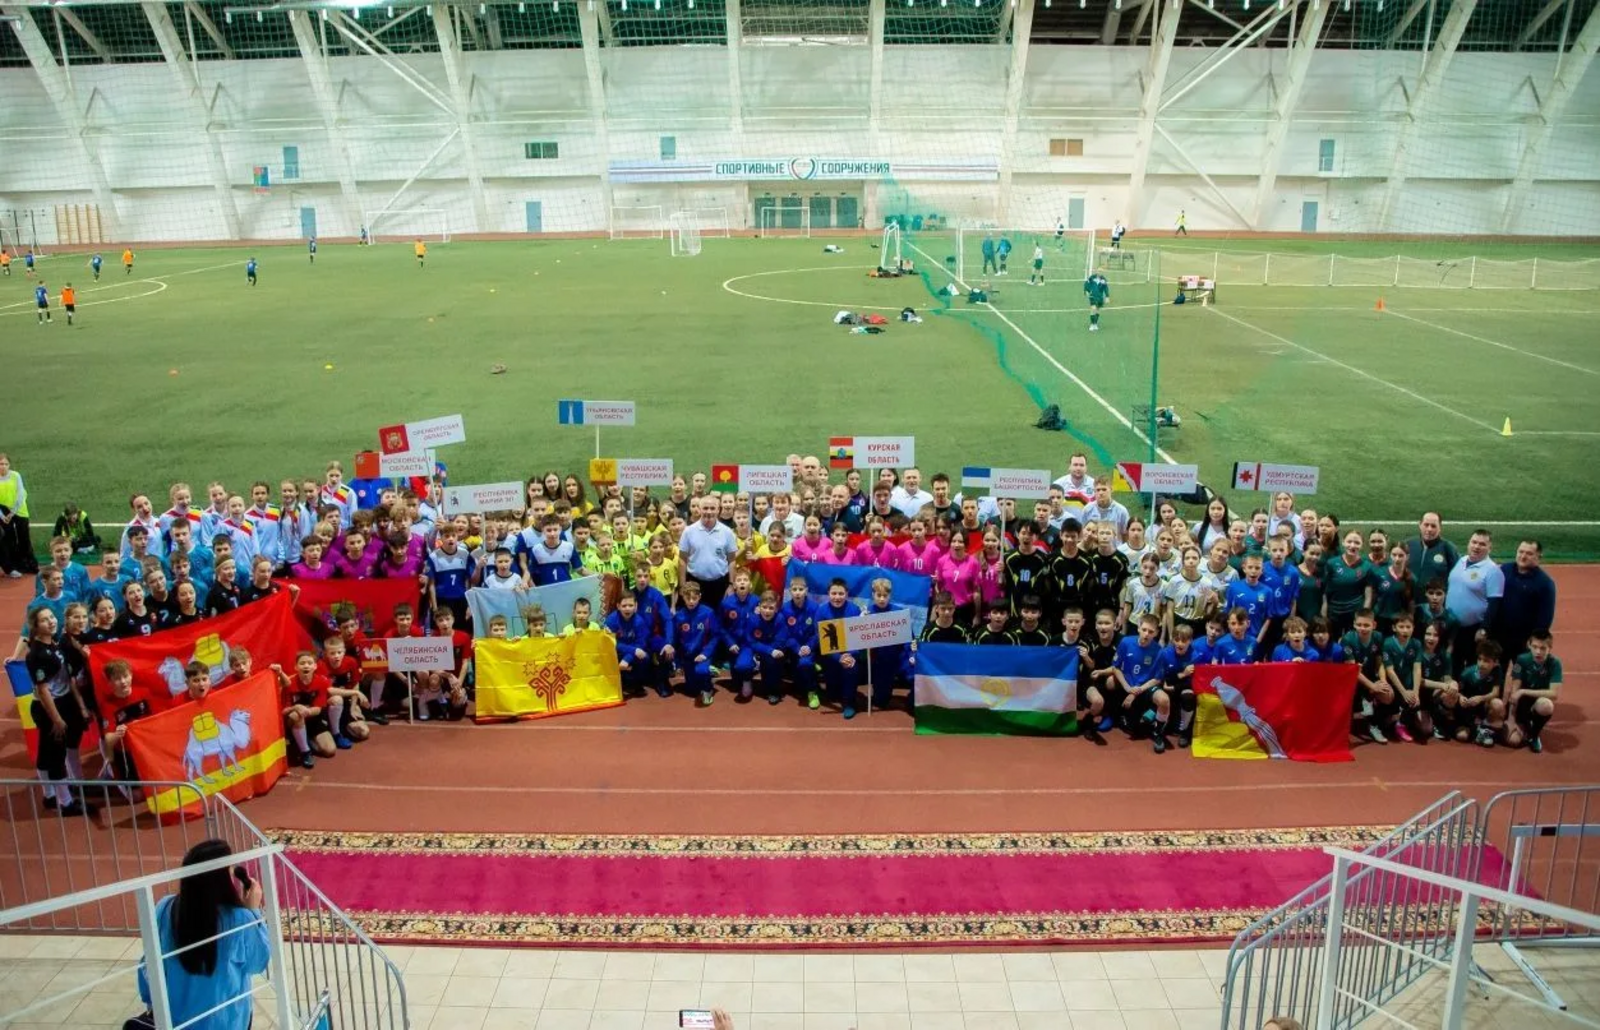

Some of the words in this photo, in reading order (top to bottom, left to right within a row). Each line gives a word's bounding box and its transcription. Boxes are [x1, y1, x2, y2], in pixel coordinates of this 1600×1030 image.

[715, 162, 785, 175] СПОРТИВНЫЕ
[821, 162, 890, 174] СООРУЖЕНИЯ
[867, 443, 901, 452] КУРСКАЯ
[867, 456, 900, 464] ОБЛАСТЬ
[389, 464, 423, 472] ОБЛАСТЬ
[746, 471, 788, 479] ЛИПЕЦКАЯ
[1266, 470, 1315, 480] УДМУРТСКАЯ
[1265, 479, 1314, 488] РЕСПУБЛИКА
[473, 489, 518, 499] РЕСПУБЛИКА
[850, 505, 861, 515] 10
[913, 558, 923, 569] 10
[552, 568, 558, 580] 1
[953, 570, 960, 583] 7
[1020, 569, 1031, 582] 10
[1101, 572, 1108, 584] 5
[450, 574, 457, 586] 7
[1067, 573, 1074, 587] 8
[1274, 587, 1282, 598] 6
[1184, 594, 1195, 608] 11
[1143, 601, 1151, 613] 3
[1248, 603, 1256, 615] 2
[159, 609, 169, 622] 7
[140, 624, 151, 636] 9
[848, 618, 907, 633] ЯРОСЛАВСКАЯ
[860, 630, 897, 641] ОБЛАСТЬ
[393, 645, 448, 655] ЧЕЛЯБИНСКАЯ
[404, 655, 439, 664] ОБЛАСТЬ
